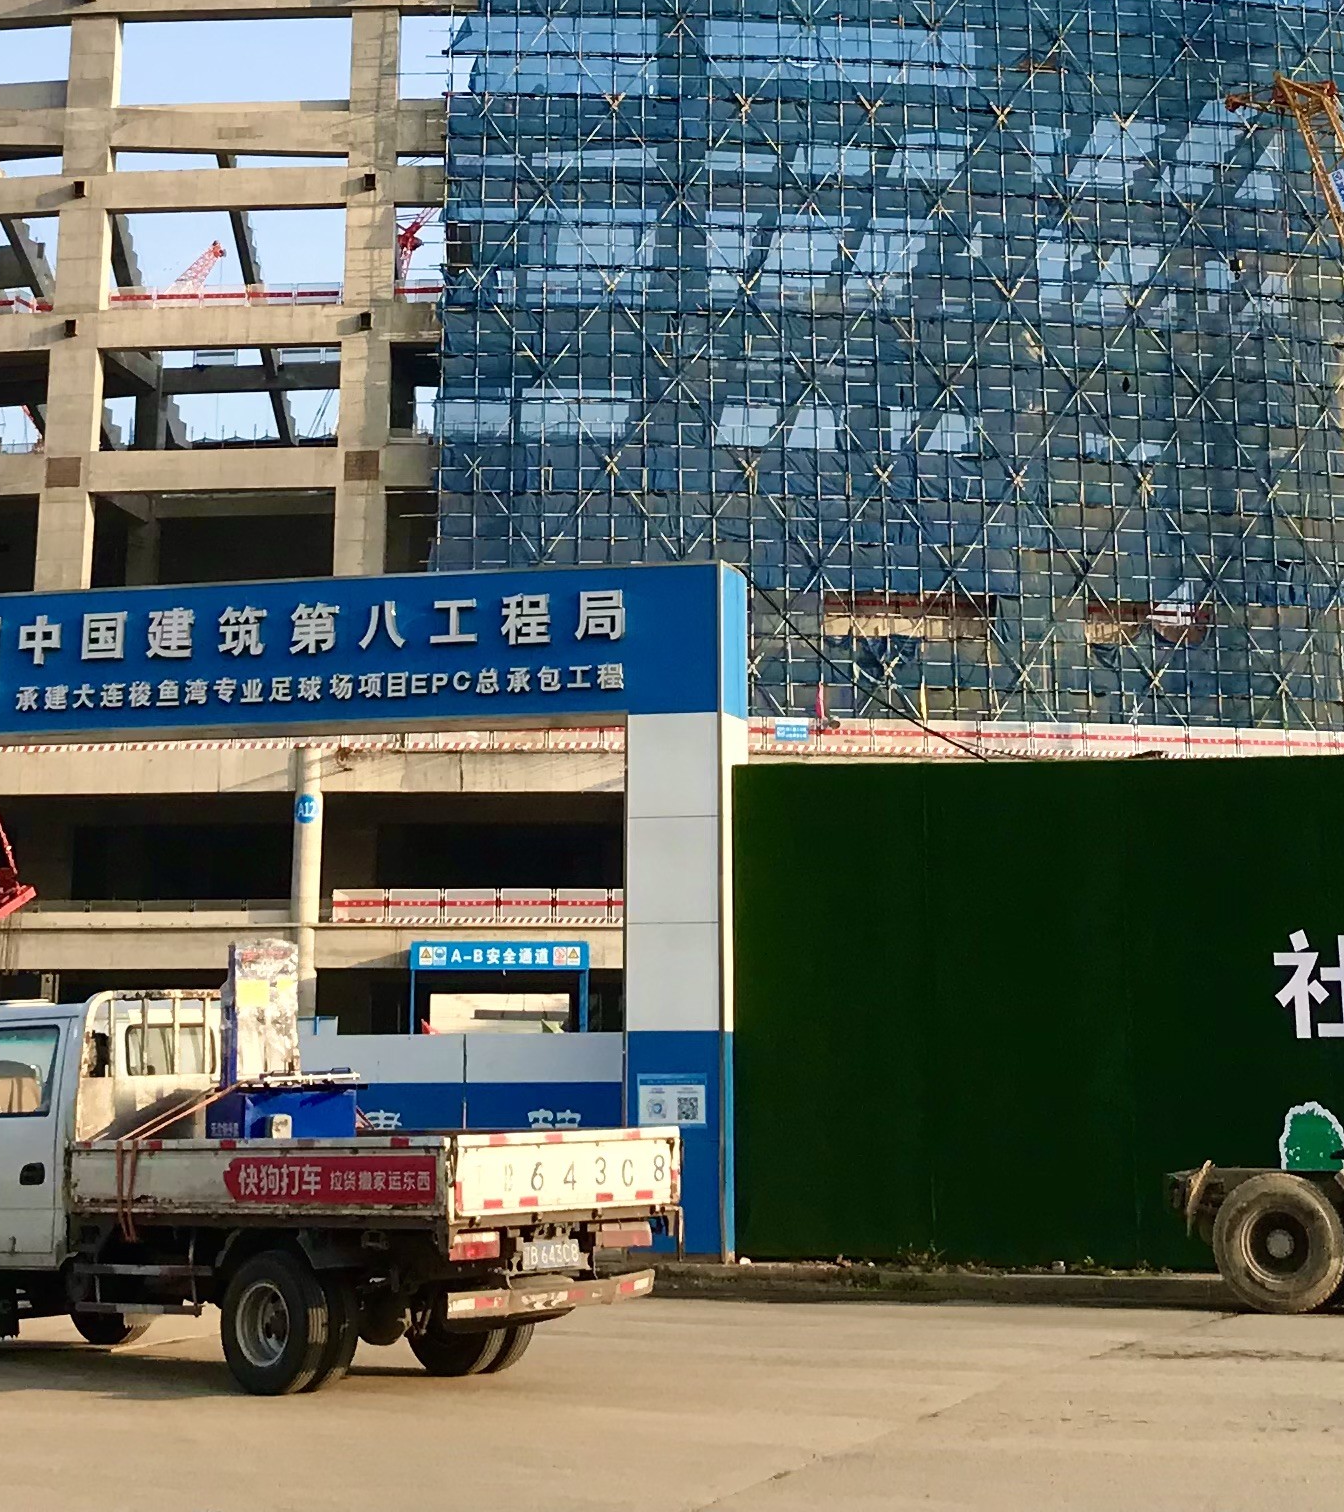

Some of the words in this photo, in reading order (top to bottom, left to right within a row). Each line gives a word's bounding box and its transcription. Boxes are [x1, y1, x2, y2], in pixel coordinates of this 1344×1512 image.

[18, 588, 627, 666] 中国建筑第八工程局
[15, 662, 626, 713] 承建大连梭鱼湾专业足球场项目EPC总承包工程
[451, 946, 549, 965] A-B安全通道
[238, 1163, 322, 1196] 快狗打车
[330, 1169, 431, 1191] 拉货搬家运东西
